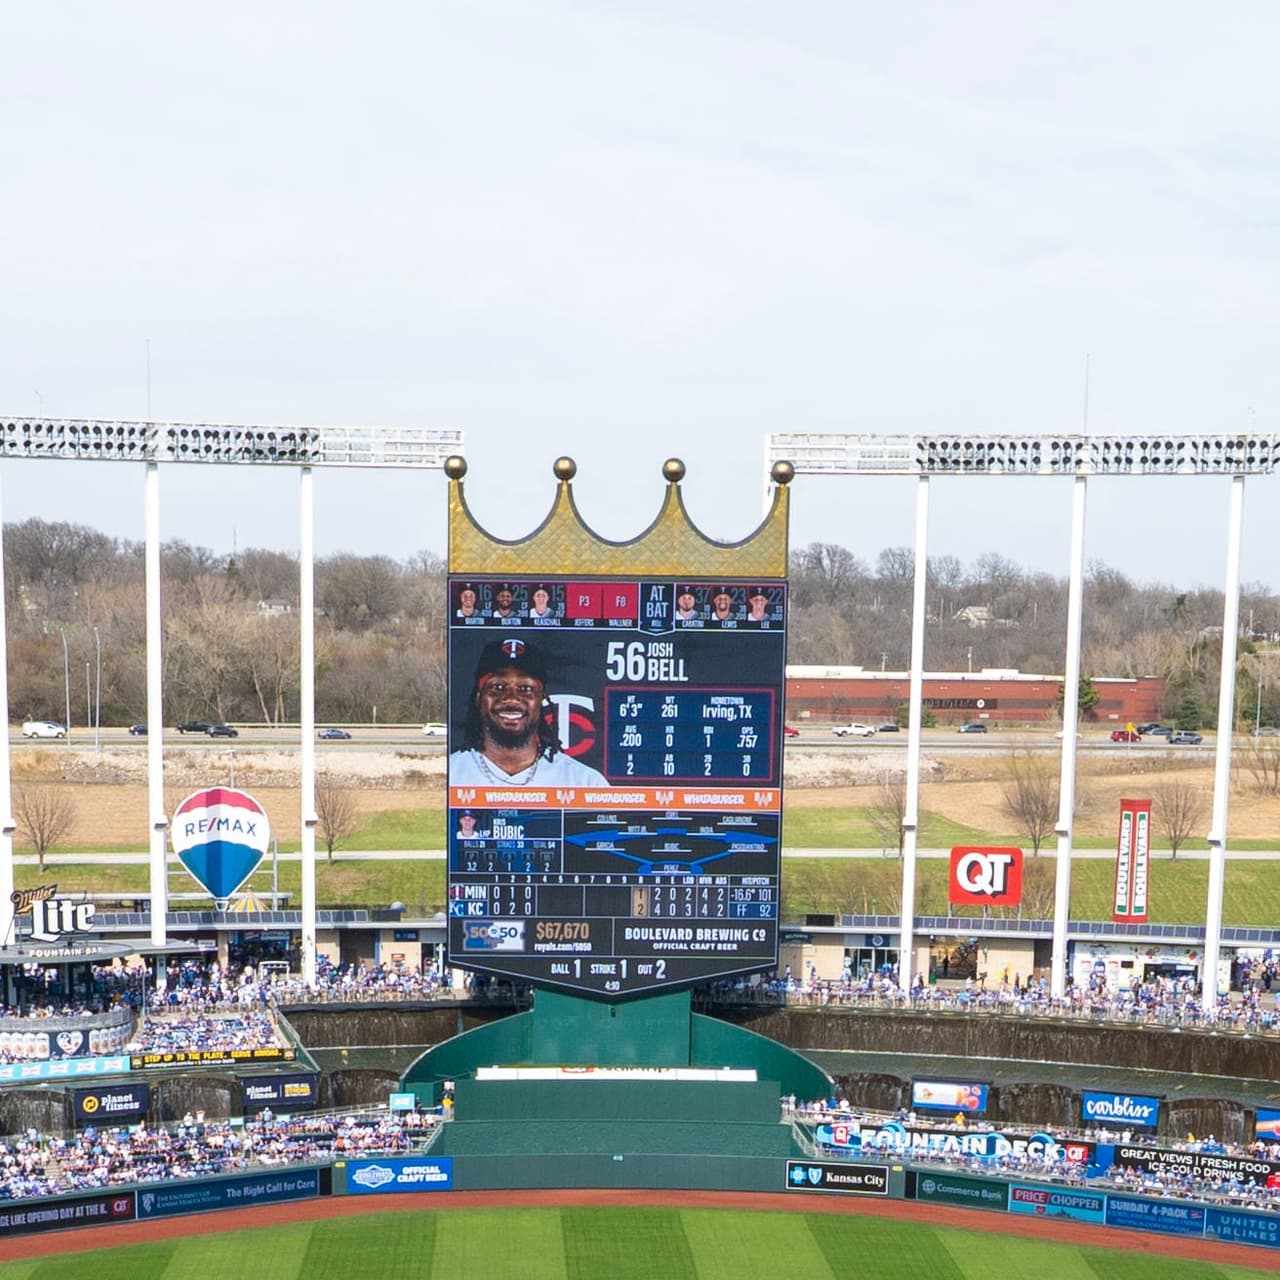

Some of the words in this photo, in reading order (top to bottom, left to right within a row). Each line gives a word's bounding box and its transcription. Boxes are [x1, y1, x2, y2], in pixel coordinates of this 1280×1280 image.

[650, 586, 665, 601] AT
[646, 602, 669, 618] BAT
[647, 642, 673, 658] JOSH
[606, 641, 646, 681] 56
[647, 658, 689, 682] BELL
[661, 704, 678, 718] 261
[702, 704, 737, 722] Irving,
[739, 705, 752, 719] TX
[619, 733, 642, 748] .200
[665, 734, 673, 748] 0
[705, 735, 711, 748] 1
[736, 735, 758, 749] .757
[485, 791, 548, 804] WHATABURGER
[584, 792, 647, 805] WHATABURGER
[683, 793, 745, 806] WHATABURGER
[185, 816, 256, 838] RE/MAX
[493, 825, 525, 839] BUBIC
[956, 851, 1015, 897] QT
[464, 886, 487, 899] MIN
[467, 902, 483, 916] KC
[30, 899, 96, 943] Lite
[535, 922, 590, 941] $67,670
[624, 927, 693, 941] BOULEVARD
[696, 928, 749, 942] BREWING
[29, 948, 82, 957] FOUNTAIN
[85, 946, 103, 955] BAR
[550, 963, 570, 975] BALL
[573, 958, 581, 978] 1
[590, 963, 616, 975] STRIKE
[619, 959, 628, 979] 1
[637, 964, 653, 975] OUT
[655, 959, 666, 979] 2
[246, 1085, 272, 1097] planet
[250, 1090, 278, 1100] fitness
[101, 1093, 133, 1107] planet
[106, 1101, 140, 1112] fitness
[1086, 1096, 1154, 1120] carbliss
[860, 1128, 987, 1156] FOUNTAIN
[995, 1139, 1066, 1159] DECK
[1067, 1146, 1084, 1162] QT
[1121, 1149, 1158, 1161] GREAT
[1159, 1151, 1193, 1164] VIEWS
[1201, 1156, 1237, 1170] FRESH
[1239, 1160, 1270, 1174] FOOD
[396, 1174, 423, 1183] CRAFT
[424, 1173, 448, 1182] BEER
[402, 1166, 441, 1175] OFFICIAL
[825, 1171, 861, 1185] Kansas
[863, 1173, 885, 1188] City
[226, 1187, 242, 1199] The
[243, 1184, 265, 1199] Right
[266, 1183, 284, 1195] Call
[283, 1182, 296, 1194] for
[297, 1180, 316, 1192] Care
[936, 1183, 978, 1197] Commerce
[979, 1188, 1003, 1201] Bank
[1015, 1189, 1045, 1203] PRICE
[1051, 1194, 1100, 1210] CHOPPER
[10, 1213, 26, 1227] LIKE
[26, 1209, 58, 1225] OPENING
[59, 1207, 75, 1221] DAY
[75, 1206, 85, 1218] AT
[85, 1204, 101, 1218] THE
[1110, 1199, 1149, 1214] SUNDAY
[1151, 1205, 1188, 1220] 4-PACK
[1220, 1215, 1278, 1231] UNITED
[1206, 1225, 1277, 1242] AIRLINES
